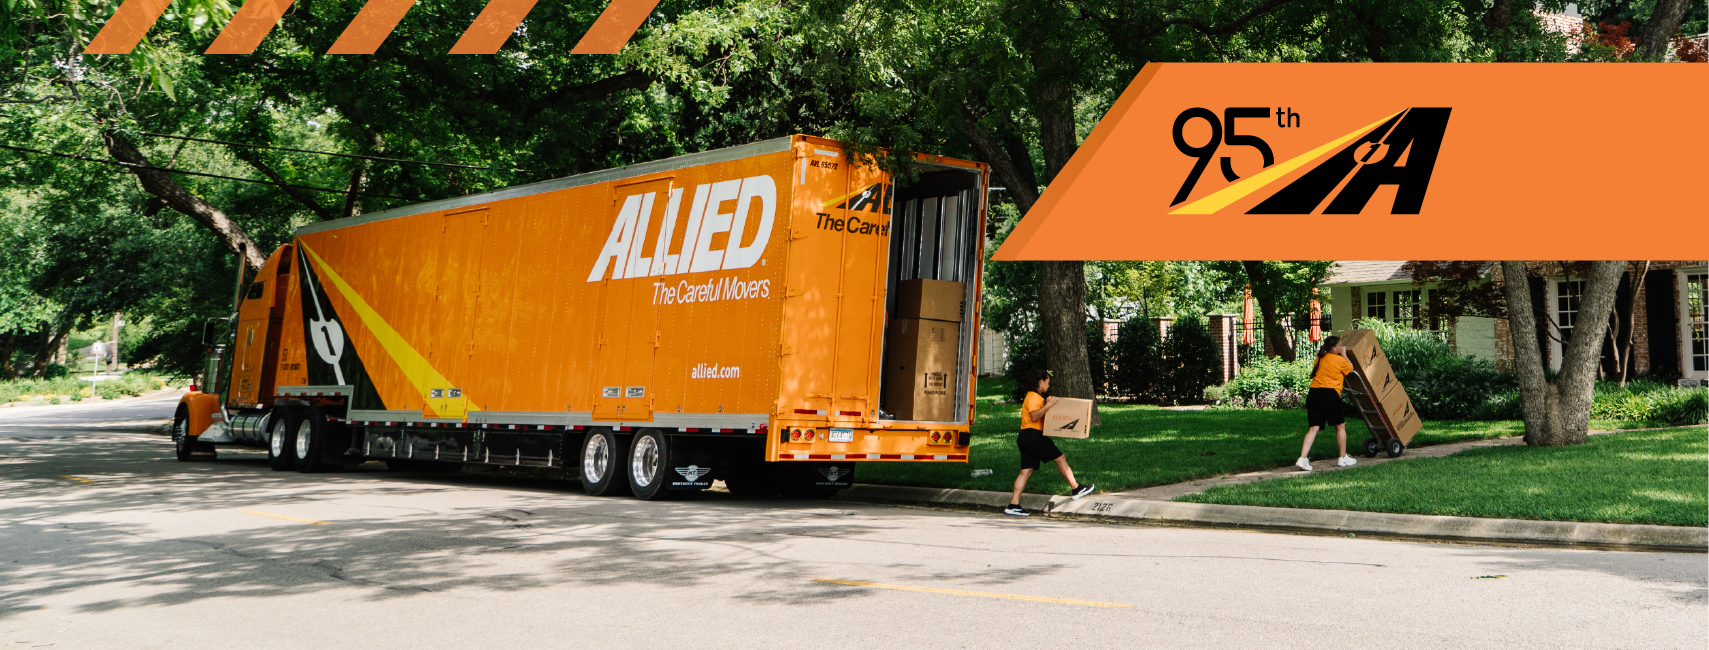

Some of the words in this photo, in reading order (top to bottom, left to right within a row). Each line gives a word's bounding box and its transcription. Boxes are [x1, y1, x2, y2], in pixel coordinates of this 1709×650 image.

[587, 175, 777, 282] ALLIED
[816, 213, 844, 231] The
[653, 282, 675, 305] The
[677, 278, 723, 304] Careful
[722, 276, 770, 300] Movers
[691, 363, 740, 379] allied.com
